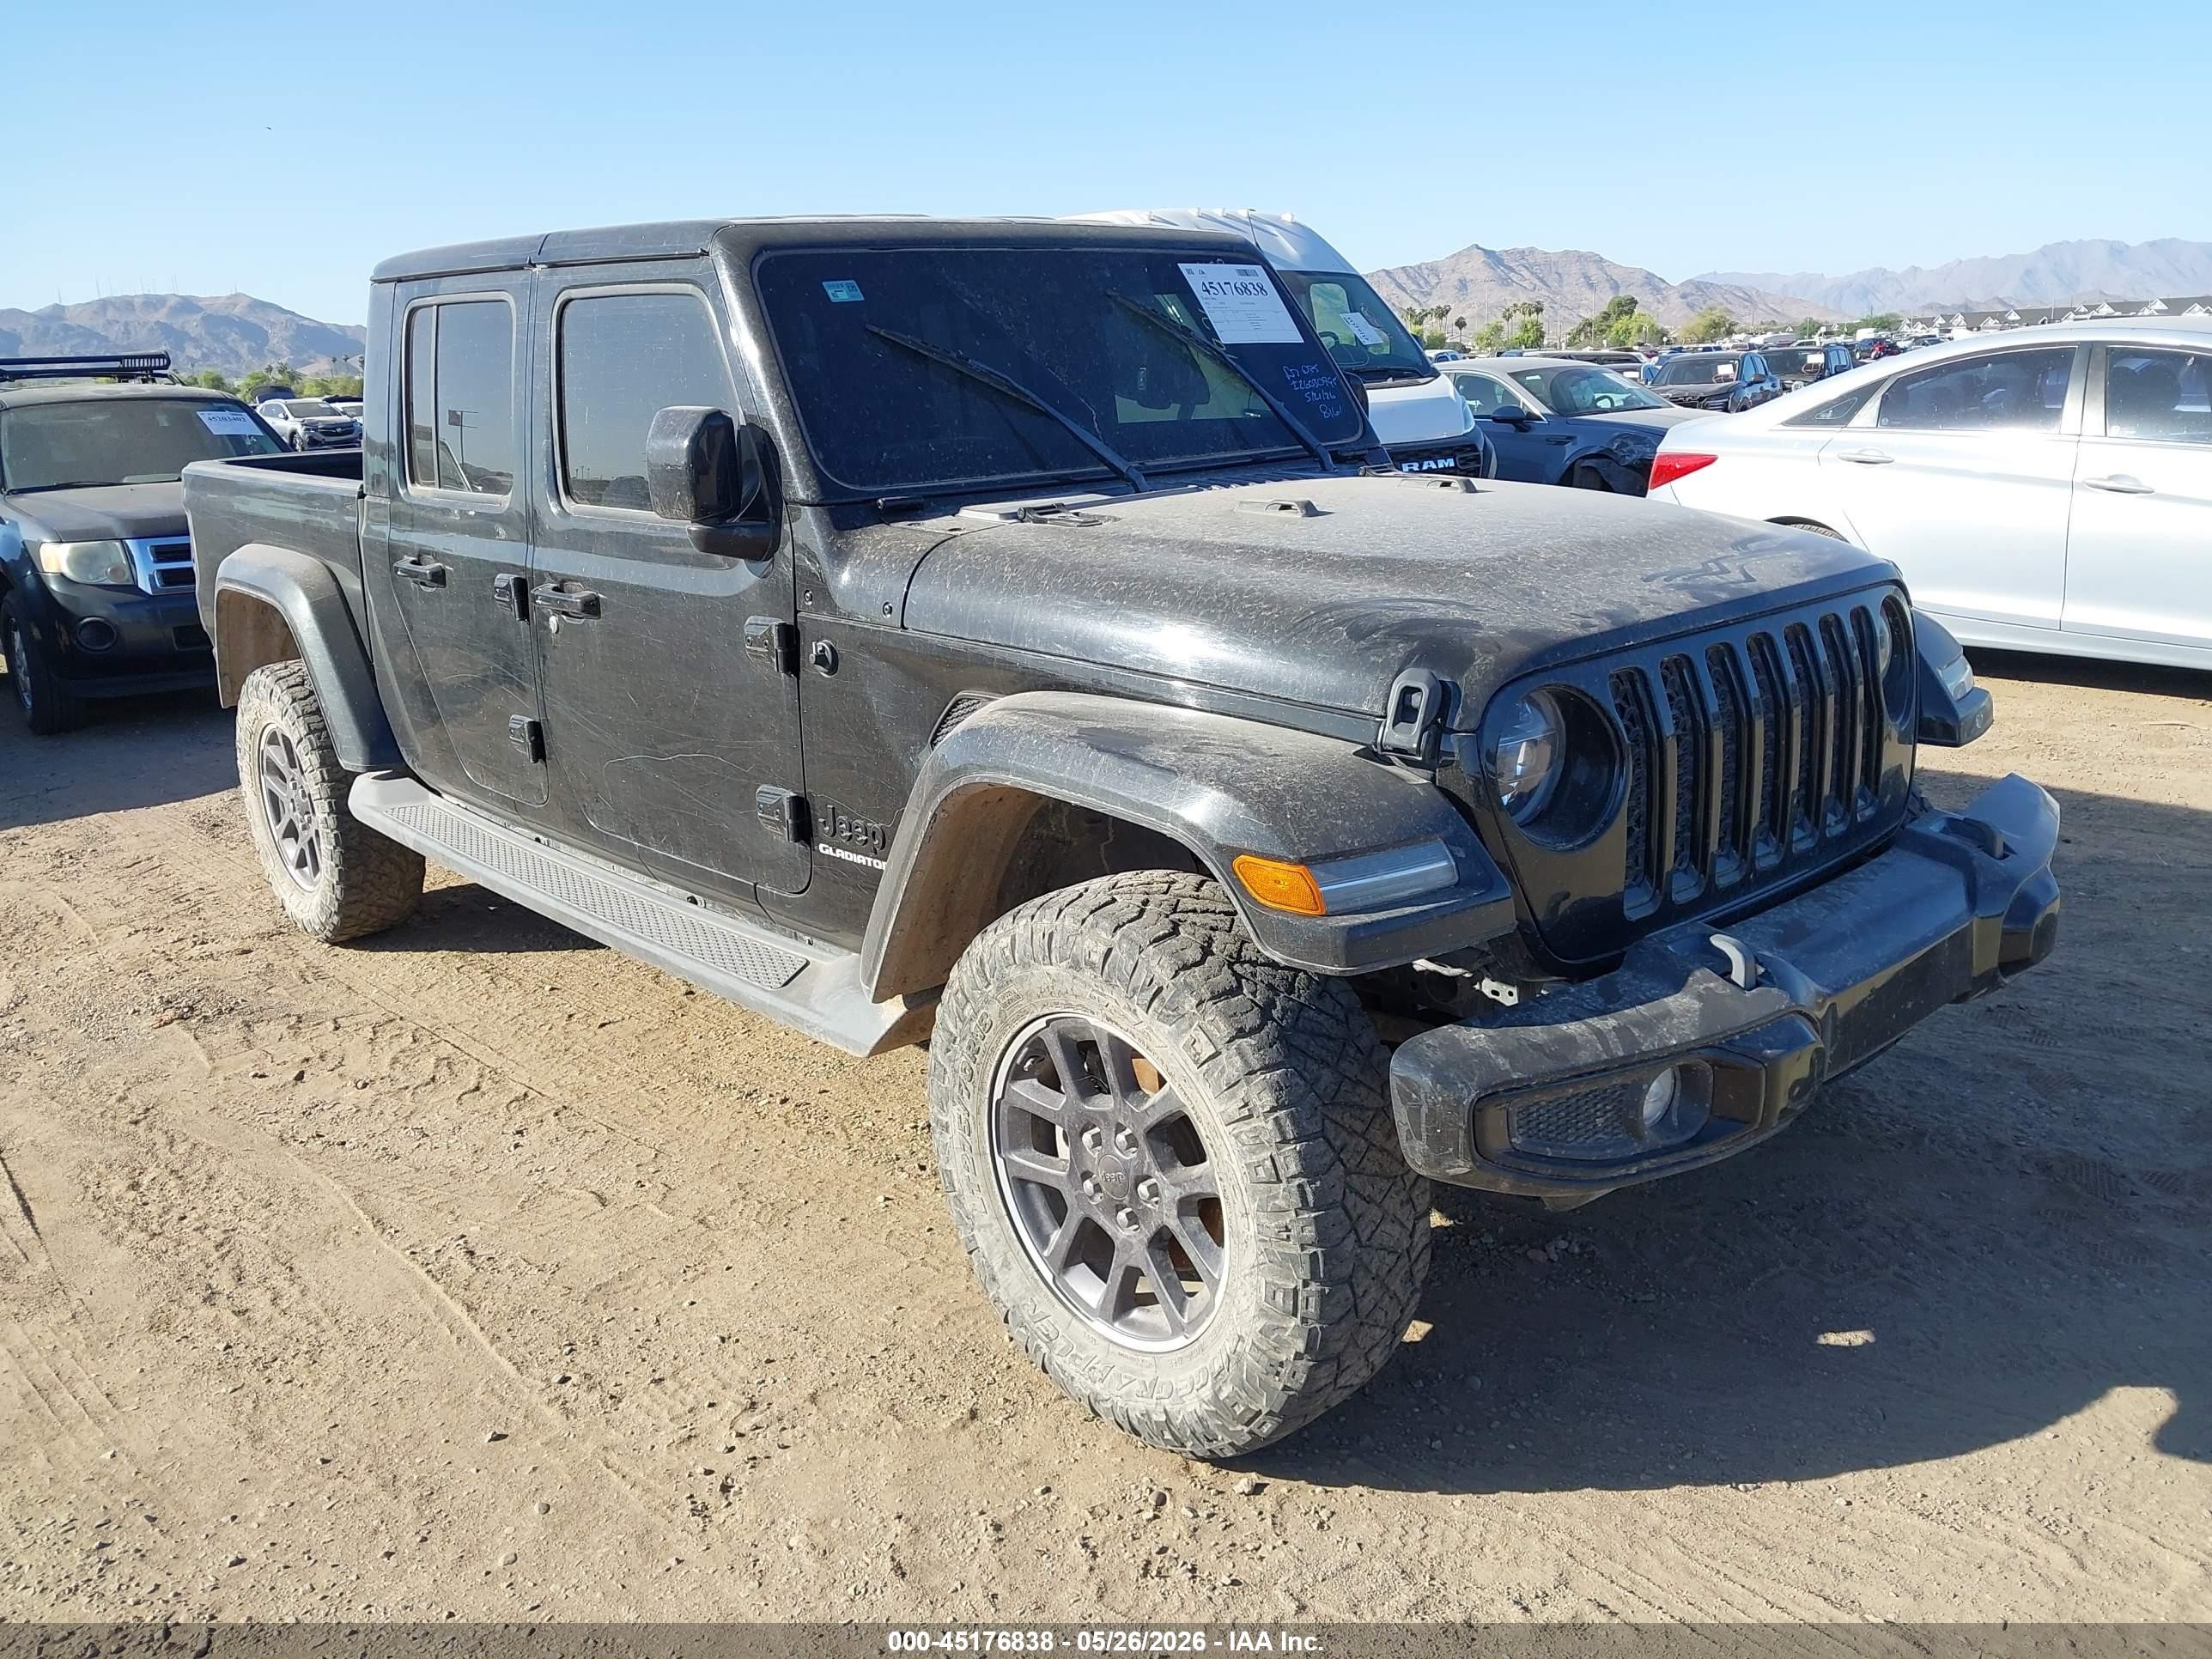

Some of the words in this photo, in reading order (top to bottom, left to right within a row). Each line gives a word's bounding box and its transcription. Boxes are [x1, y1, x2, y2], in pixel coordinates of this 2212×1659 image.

[1201, 281, 1268, 296] 45176838
[1401, 458, 1455, 472] RAM
[817, 804, 886, 855] Jeep
